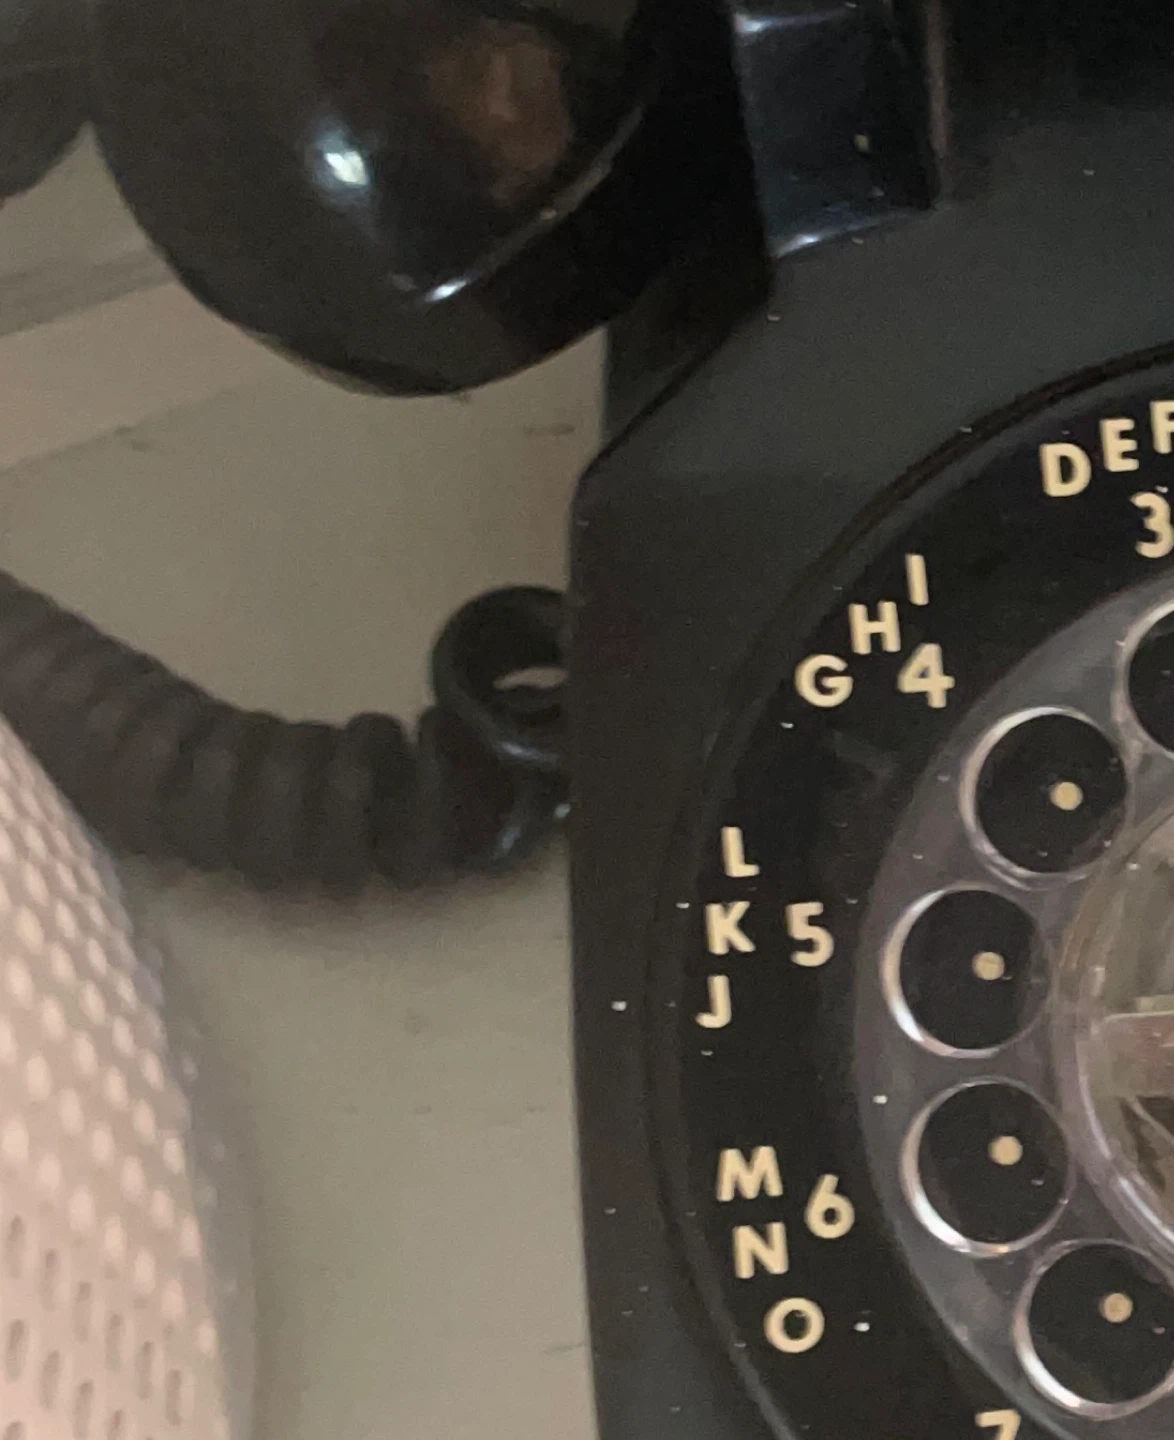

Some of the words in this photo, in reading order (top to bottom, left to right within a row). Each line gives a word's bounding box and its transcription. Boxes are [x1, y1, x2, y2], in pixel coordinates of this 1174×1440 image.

[897, 643, 956, 709] 4
[786, 900, 836, 968] 5
[804, 1173, 856, 1240] 6
